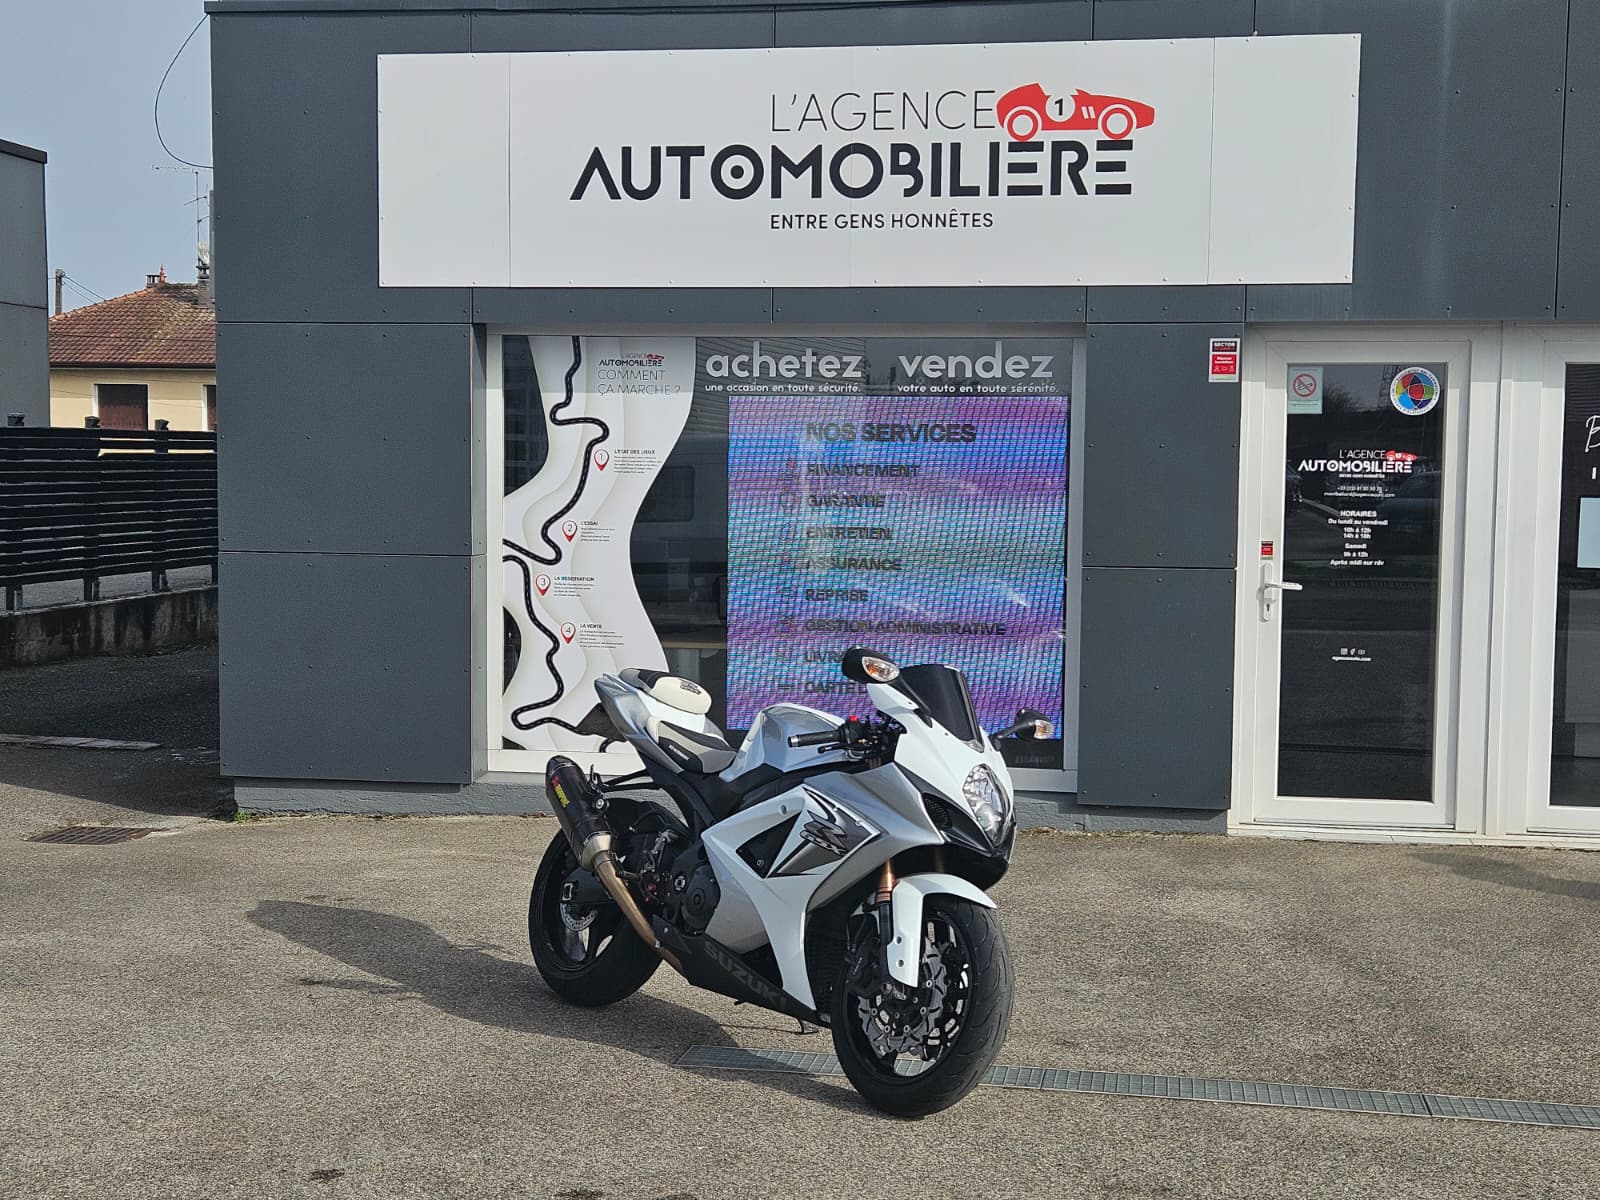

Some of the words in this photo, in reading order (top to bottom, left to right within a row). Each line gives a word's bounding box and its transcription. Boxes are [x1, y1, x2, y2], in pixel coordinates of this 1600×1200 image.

[771, 90, 995, 132] L'AGENCE
[569, 139, 1133, 201] AUTOMOBILIERE
[770, 214, 828, 230] ENTRE
[834, 213, 885, 229] GENS
[891, 208, 994, 229] HONNÊTES
[705, 340, 862, 378] achetez
[898, 340, 1054, 378] vendez
[597, 369, 666, 381] COMMENT
[597, 383, 614, 397] ÇA
[617, 384, 671, 395] MARCHE
[675, 384, 681, 395] ?
[704, 384, 723, 393] une
[726, 382, 769, 393] occasion
[772, 385, 784, 393] en
[787, 383, 815, 393] toute
[818, 382, 862, 393] sécurité.
[897, 384, 927, 393] votre
[930, 384, 956, 393] auto
[959, 385, 973, 393] en
[976, 384, 1007, 393] toute
[1010, 382, 1059, 394] sérénité.
[806, 421, 857, 442] NOS
[861, 422, 977, 443] SERVICES
[1339, 449, 1386, 459] L'AGENCE
[806, 463, 921, 478] FINANCEMENT
[1297, 459, 1413, 473] AUTOMOBILIERE
[1340, 510, 1377, 518] HORAIRES
[805, 588, 869, 602] REPRISE
[704, 940, 786, 1008] SUZUKI
